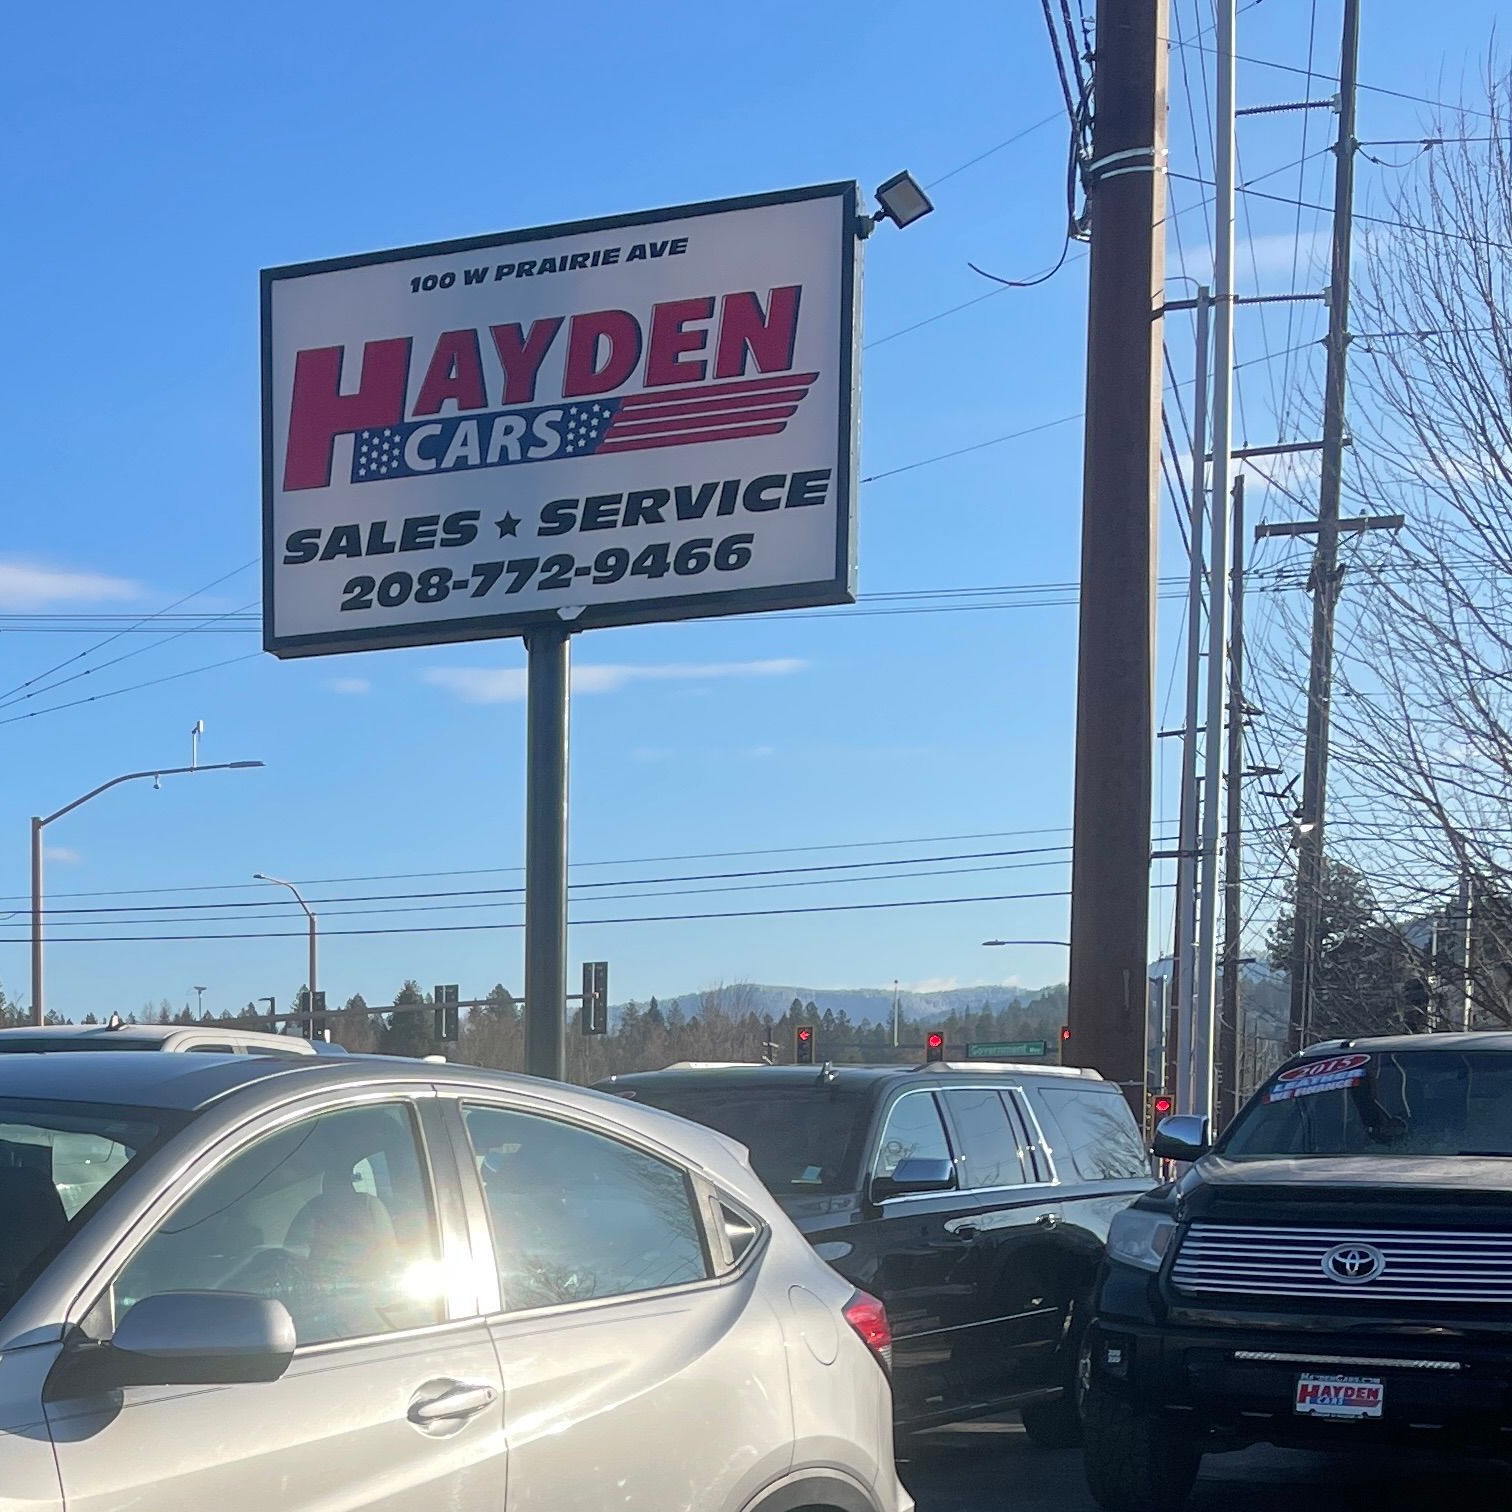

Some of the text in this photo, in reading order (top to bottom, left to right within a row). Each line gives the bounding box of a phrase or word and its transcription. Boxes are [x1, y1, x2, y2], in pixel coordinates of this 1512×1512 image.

[410, 237, 689, 293] 100 W PRAIRIE AVE
[282, 285, 803, 491] HAYDEN
[403, 410, 563, 471] CARS
[283, 468, 832, 564] SALES SERVICE
[340, 532, 755, 612] 208-772-9466
[1297, 1384, 1381, 1404] HAYDEN
